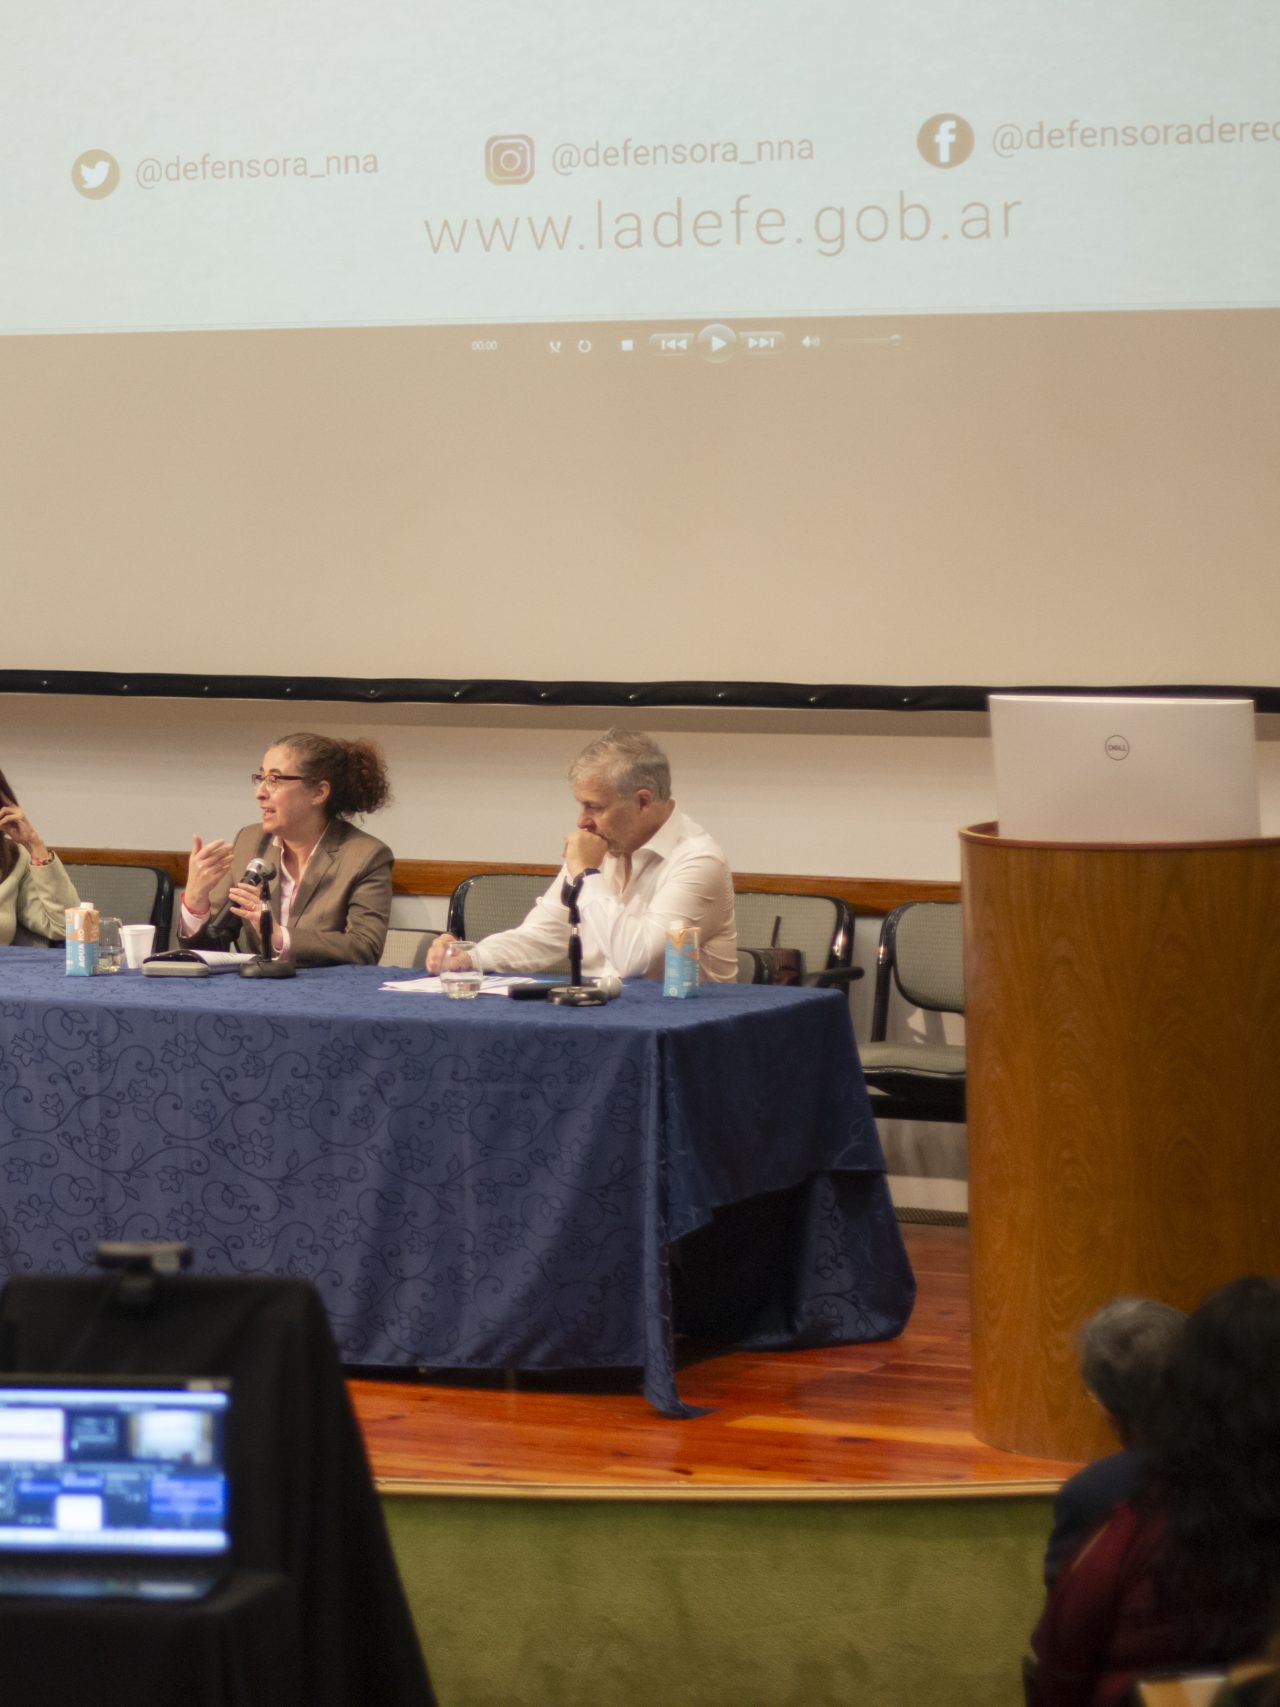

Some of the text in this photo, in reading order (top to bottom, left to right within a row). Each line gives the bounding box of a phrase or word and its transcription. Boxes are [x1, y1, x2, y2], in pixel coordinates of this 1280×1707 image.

[135, 149, 379, 190] @defensora_nna
[552, 135, 815, 177] @defensora_nna
[423, 190, 1023, 257] www.ladefe.gob.ar
[471, 340, 498, 351] 00:00
[1107, 744, 1128, 752] DELL
